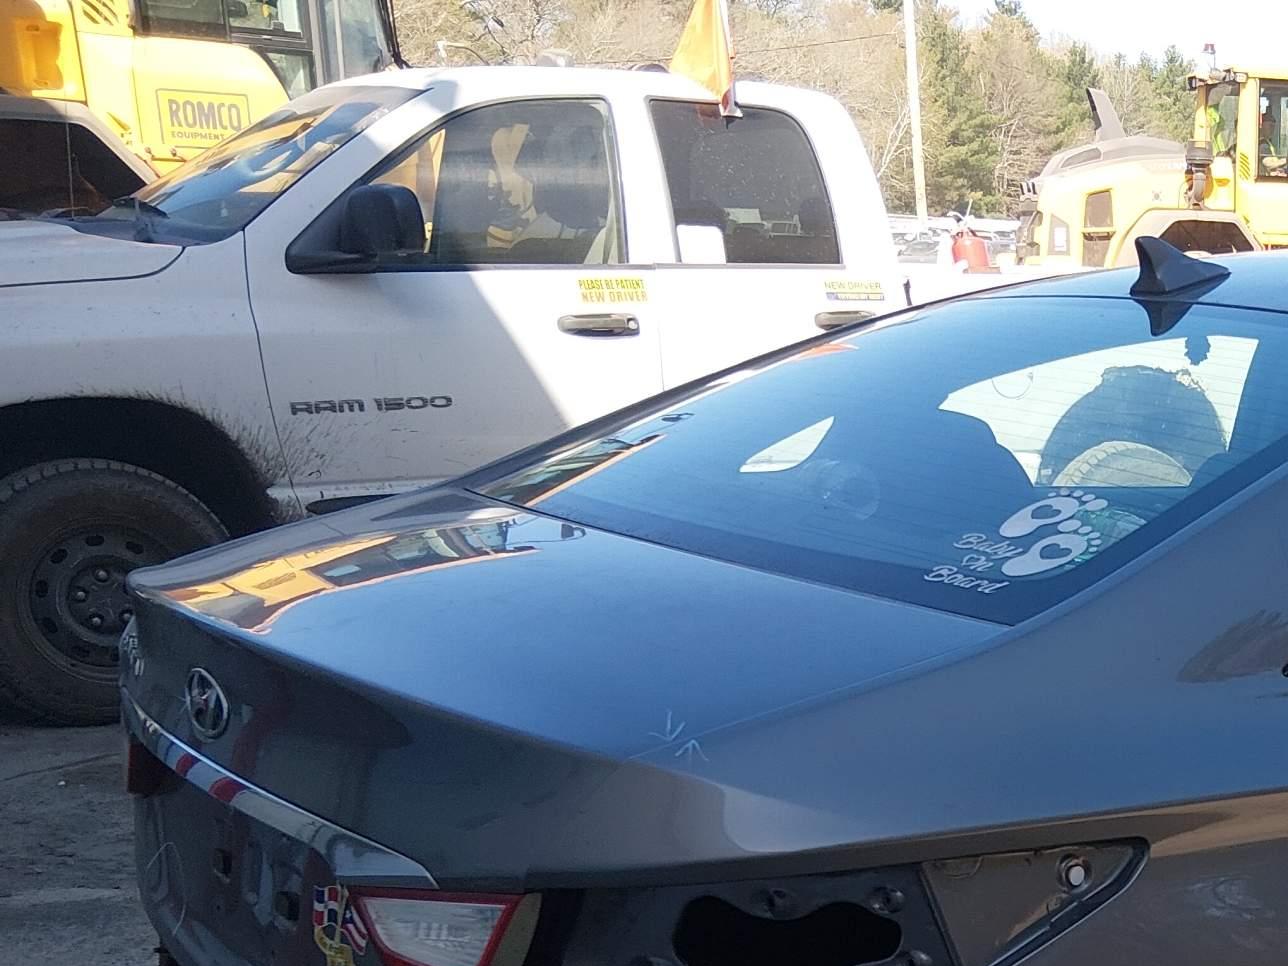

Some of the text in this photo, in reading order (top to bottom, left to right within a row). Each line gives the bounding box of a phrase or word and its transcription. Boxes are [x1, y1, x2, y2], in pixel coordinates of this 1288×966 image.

[168, 98, 241, 132] ROMCO
[171, 130, 225, 141] EQUIPMENT
[578, 279, 644, 290] PLEASE BE PATIENT
[582, 291, 648, 303] NEW DRIVER
[289, 396, 452, 415] RAM 1500
[953, 532, 1024, 559] Baby
[923, 565, 1011, 594] Board
